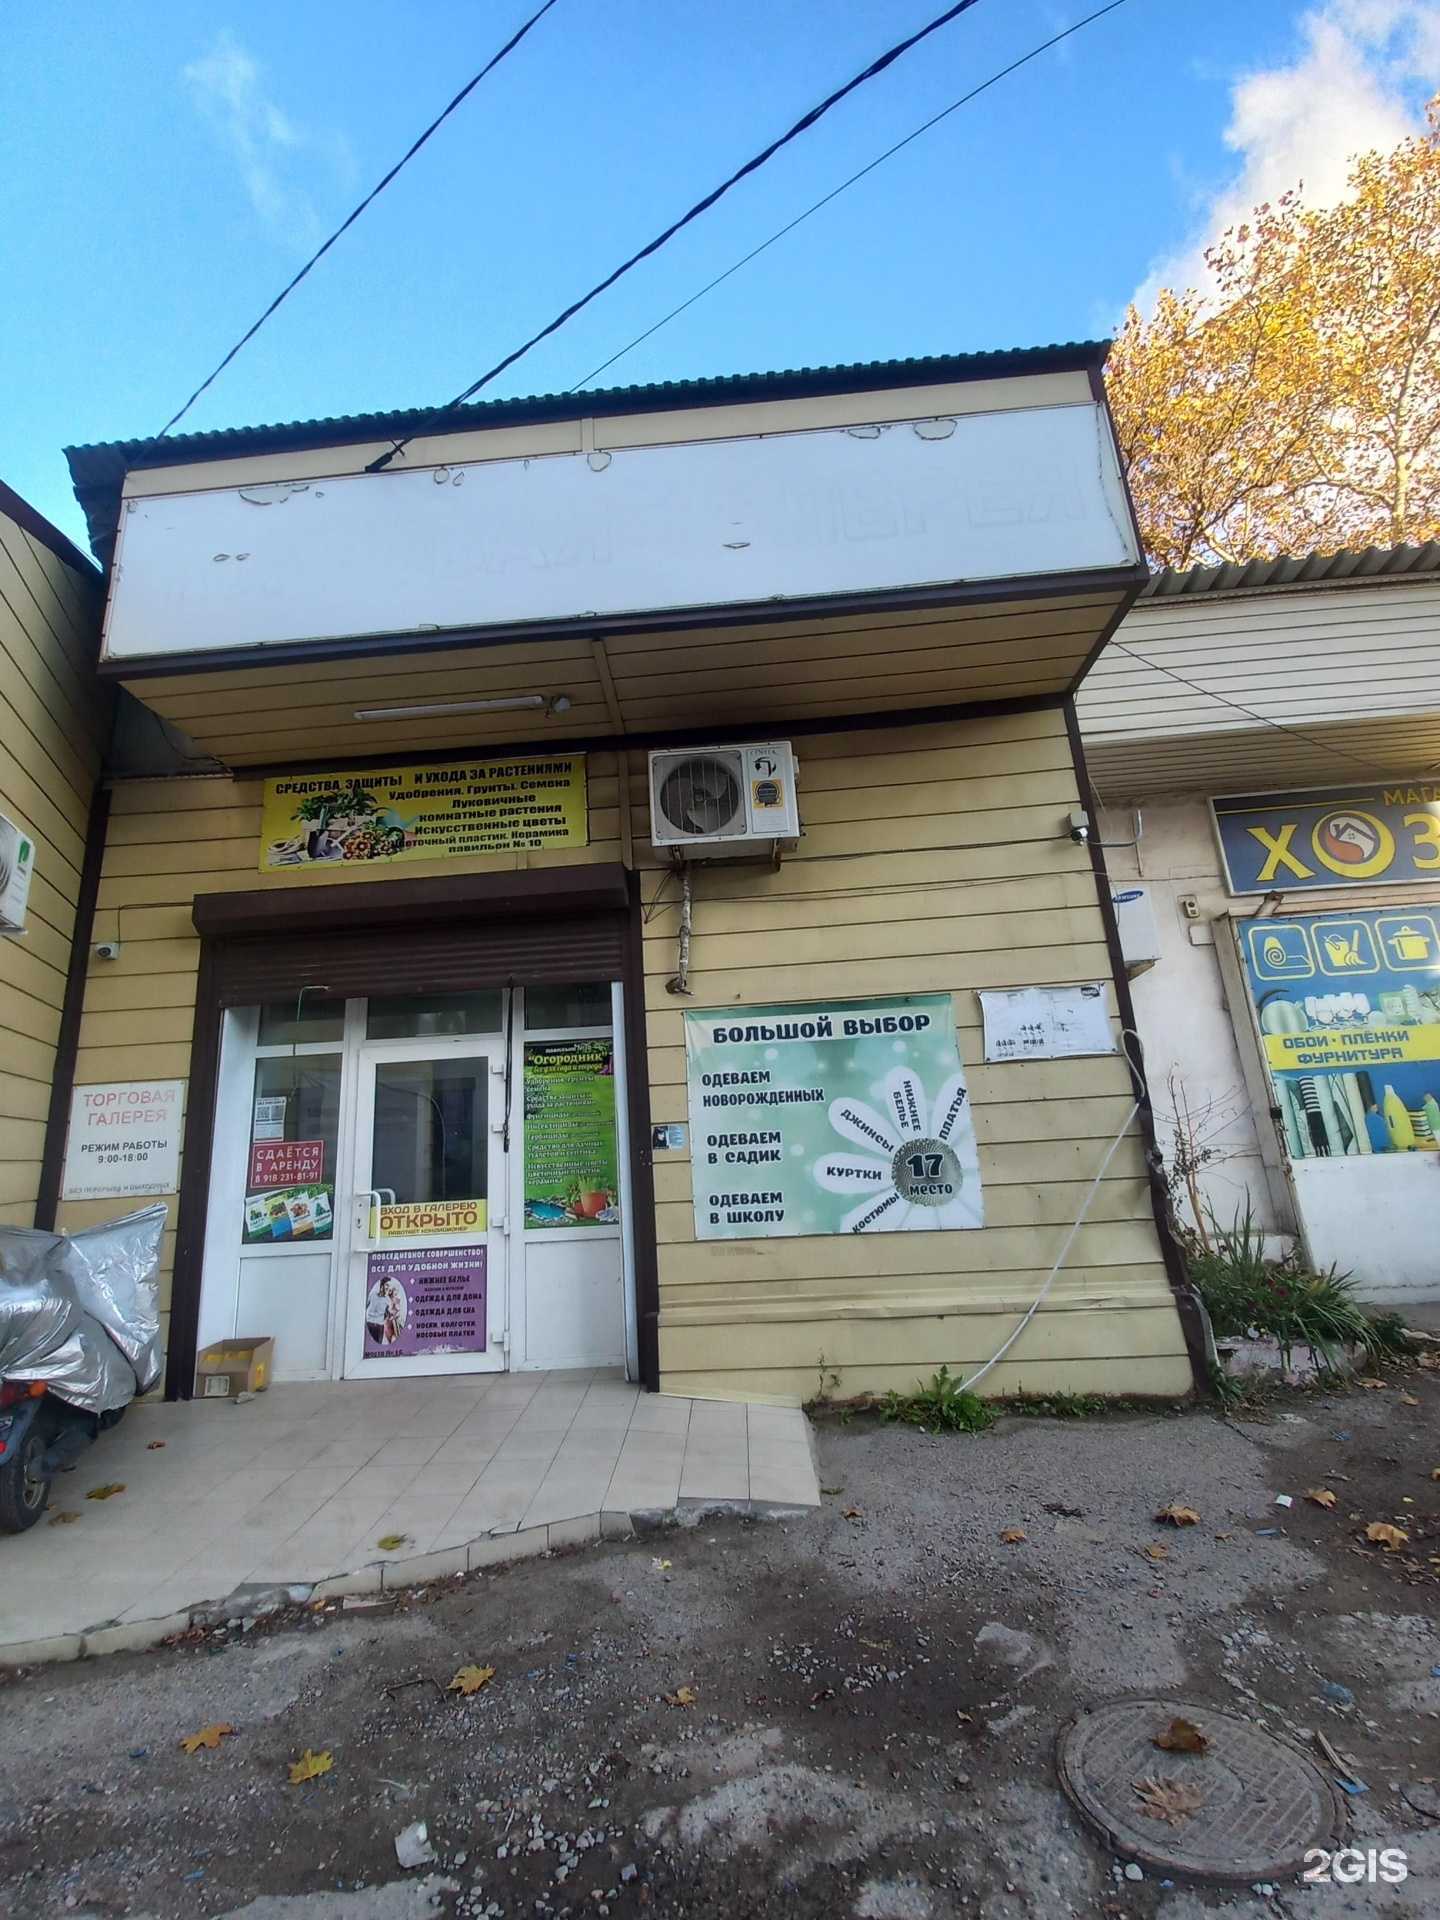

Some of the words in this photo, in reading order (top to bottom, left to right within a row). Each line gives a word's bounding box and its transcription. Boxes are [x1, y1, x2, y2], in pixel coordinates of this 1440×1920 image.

[276, 779, 340, 795] СРЕДСТВА
[345, 775, 402, 791] ЗАЩИТЫ
[414, 773, 423, 784] И
[425, 769, 467, 784] УХОДА
[469, 768, 486, 781] ЗА
[488, 761, 572, 778] РАСТЕНИЯМИ
[520, 778, 571, 791] Семена
[452, 794, 536, 809] Луковичные
[419, 808, 497, 823] комнатные
[499, 804, 562, 818] растения
[415, 818, 520, 835] Искусственные
[522, 816, 566, 829] цветы
[511, 827, 569, 840] Керамика
[448, 841, 511, 853] павильон
[529, 838, 543, 848] 10
[712, 1015, 833, 1044] БОЛЬШОЙ
[843, 1014, 930, 1036] ВЫБОР
[1283, 1035, 1330, 1050] ОБОИ
[1340, 1030, 1410, 1047] ПЛЁНКИ
[1297, 1048, 1404, 1065] ФУРНИТУРА
[702, 1070, 771, 1088] ОДЕВАЕМ
[83, 1089, 176, 1107] ТОРГОВАЯ
[702, 1088, 825, 1107] НОВОРОЖДЕННЫХ
[903, 1080, 921, 1132] НИЖНЕЕ
[87, 1109, 168, 1127] ГАЛЕРЕЯ
[892, 1091, 909, 1129] БЕЛЬЕ
[938, 1087, 967, 1141] ПЛАТЬЯ
[81, 1142, 120, 1153] РЕЖИМ
[122, 1139, 168, 1151] РАБОТЫ
[707, 1131, 782, 1148] ОДЕВАЕМ
[256, 1146, 319, 1160] СДАЁТСЯ
[707, 1153, 718, 1164] В
[725, 1149, 782, 1165] САДИК
[256, 1162, 263, 1172] В
[270, 1159, 320, 1171] АРЕНДУ
[826, 1166, 882, 1181] КУРТКИ
[907, 1153, 944, 1179] 17
[709, 1191, 783, 1207] ОДЕВАЕМ
[380, 1206, 410, 1216] ВХОД
[413, 1205, 421, 1213] В
[424, 1201, 478, 1212] ГАЛЕРЕЮ
[709, 1212, 720, 1225] В
[726, 1209, 785, 1224] ШКОЛУ
[380, 1211, 478, 1230] ОТКРЫТО
[387, 1264, 406, 1273] ДЛЯ
[415, 1294, 445, 1303] ОДЕЖДА
[446, 1294, 461, 1302] ДЛЯ
[415, 1308, 445, 1316] ОДЕЖДА
[446, 1307, 461, 1315] ДЛЯ
